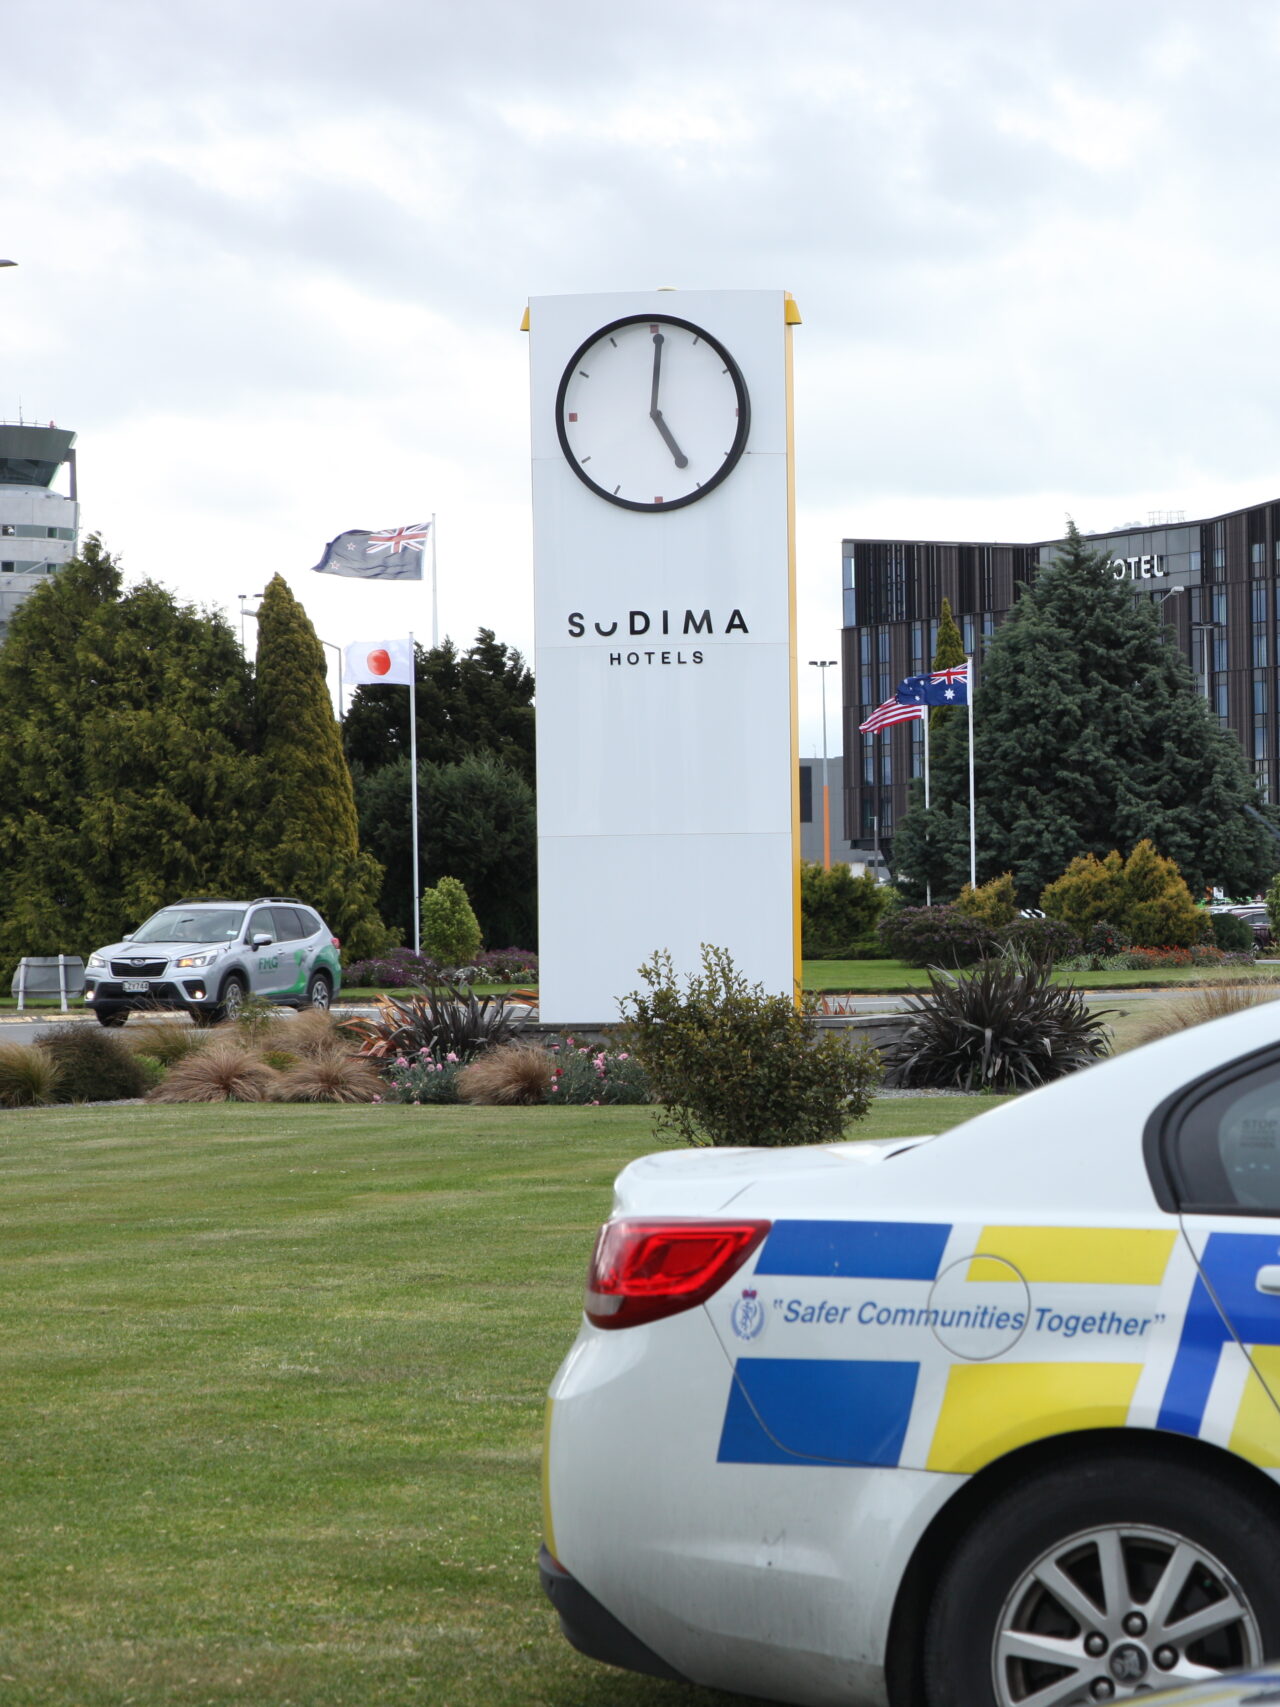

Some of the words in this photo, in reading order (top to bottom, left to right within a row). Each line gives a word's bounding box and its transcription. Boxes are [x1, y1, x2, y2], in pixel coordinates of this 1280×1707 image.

[1101, 554, 1165, 580] OTEL
[567, 609, 749, 638] SUDIMA
[610, 651, 704, 666] HOTELS
[258, 956, 278, 970] FMG
[857, 1301, 1026, 1332] Communities
